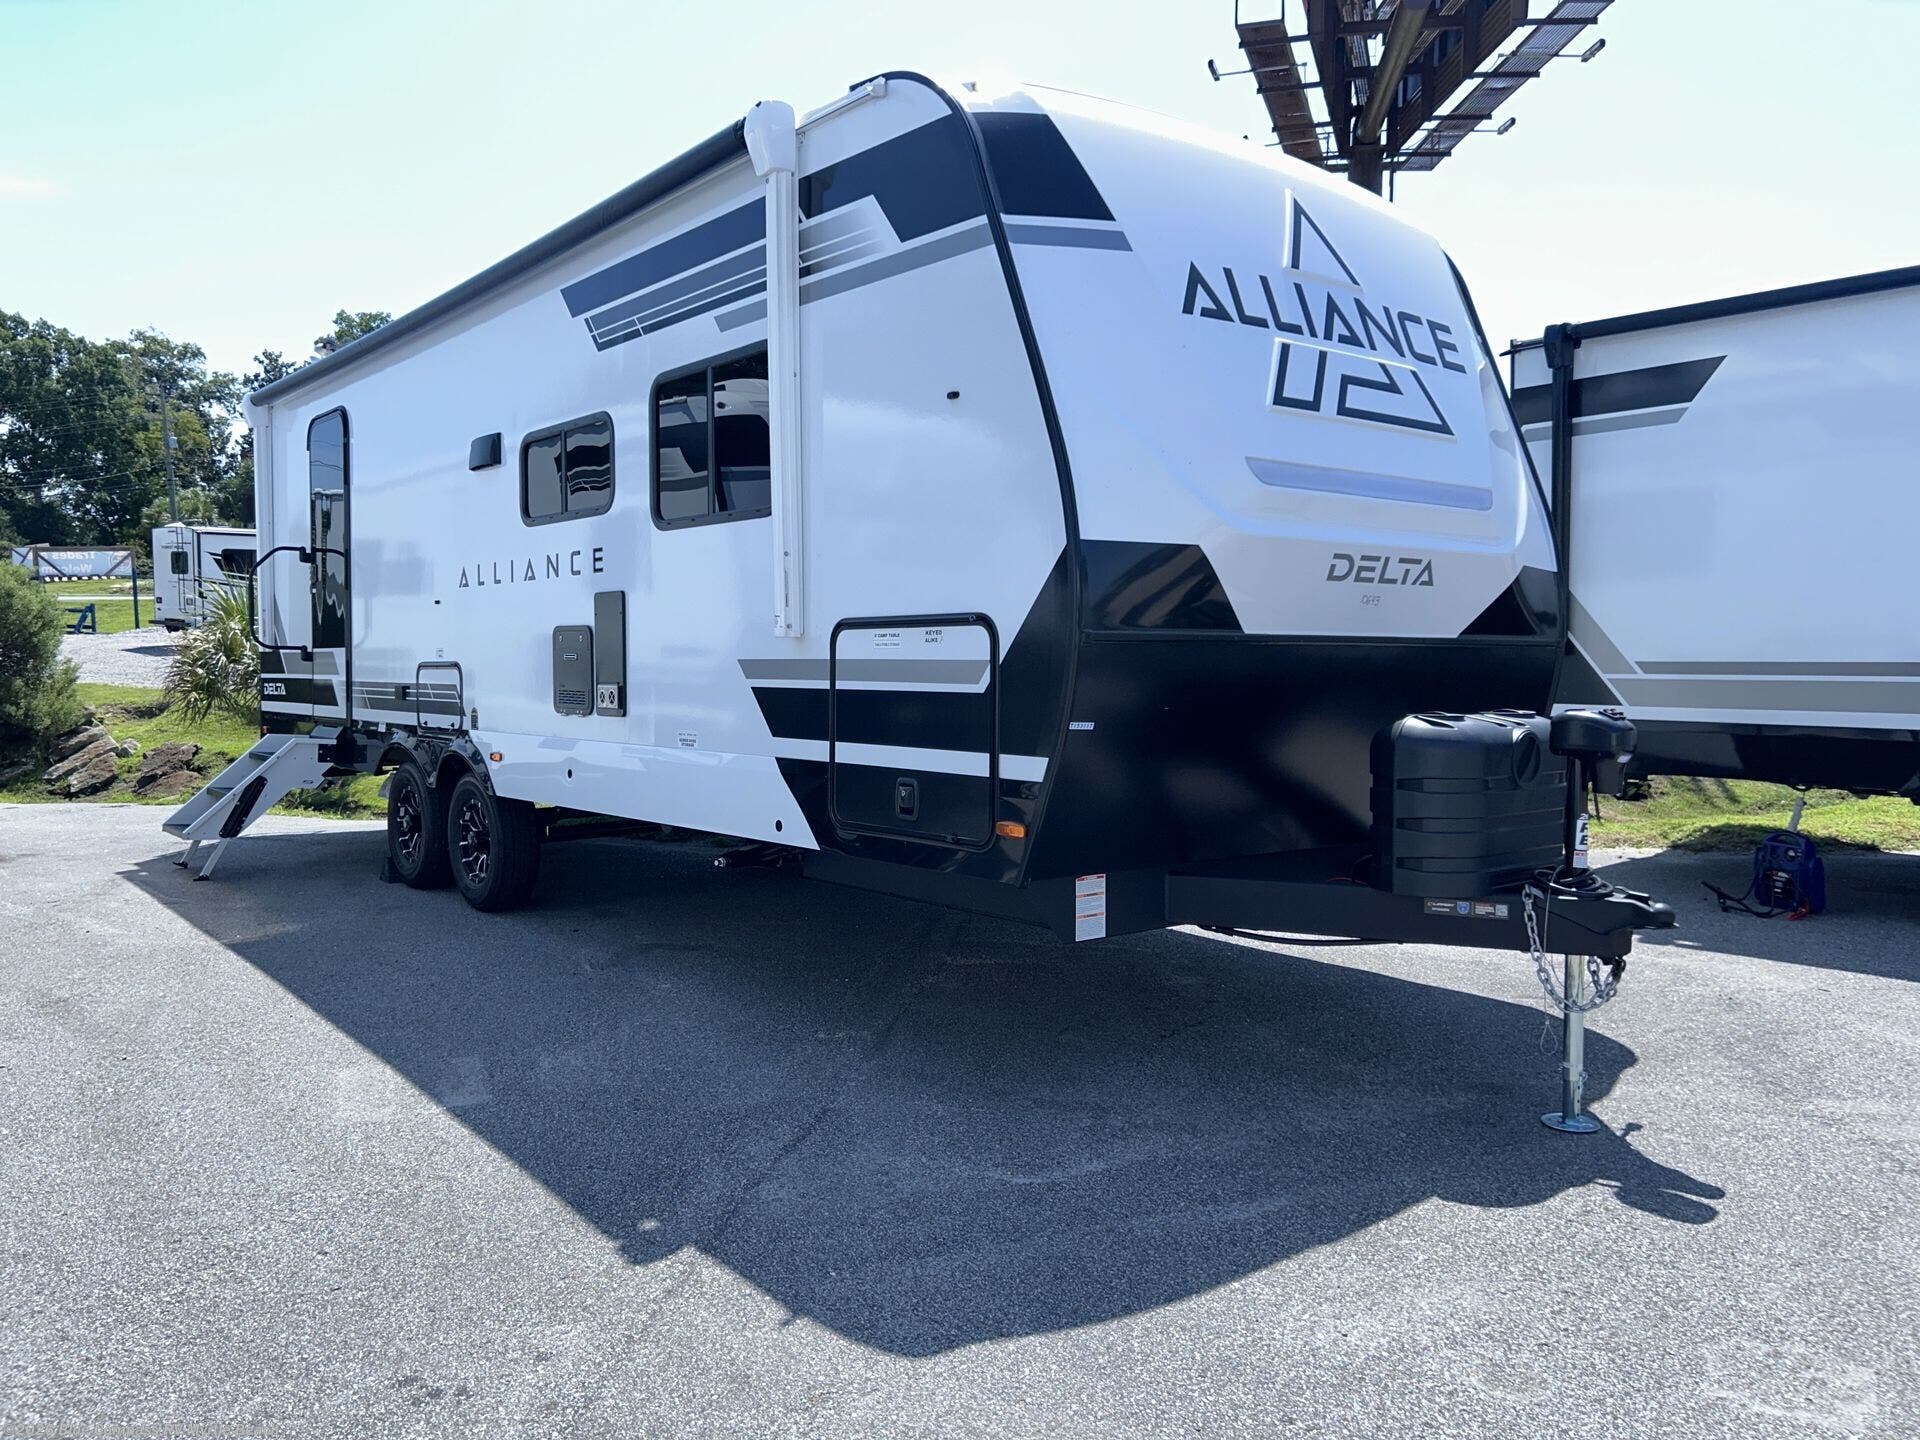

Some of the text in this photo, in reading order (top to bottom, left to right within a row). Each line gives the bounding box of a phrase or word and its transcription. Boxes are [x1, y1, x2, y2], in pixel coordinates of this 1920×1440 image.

[1182, 260, 1467, 374] ALLIANCE
[458, 547, 604, 588] ALLIANCE
[1326, 552, 1434, 587] DELTA
[263, 682, 287, 695] DELTA
